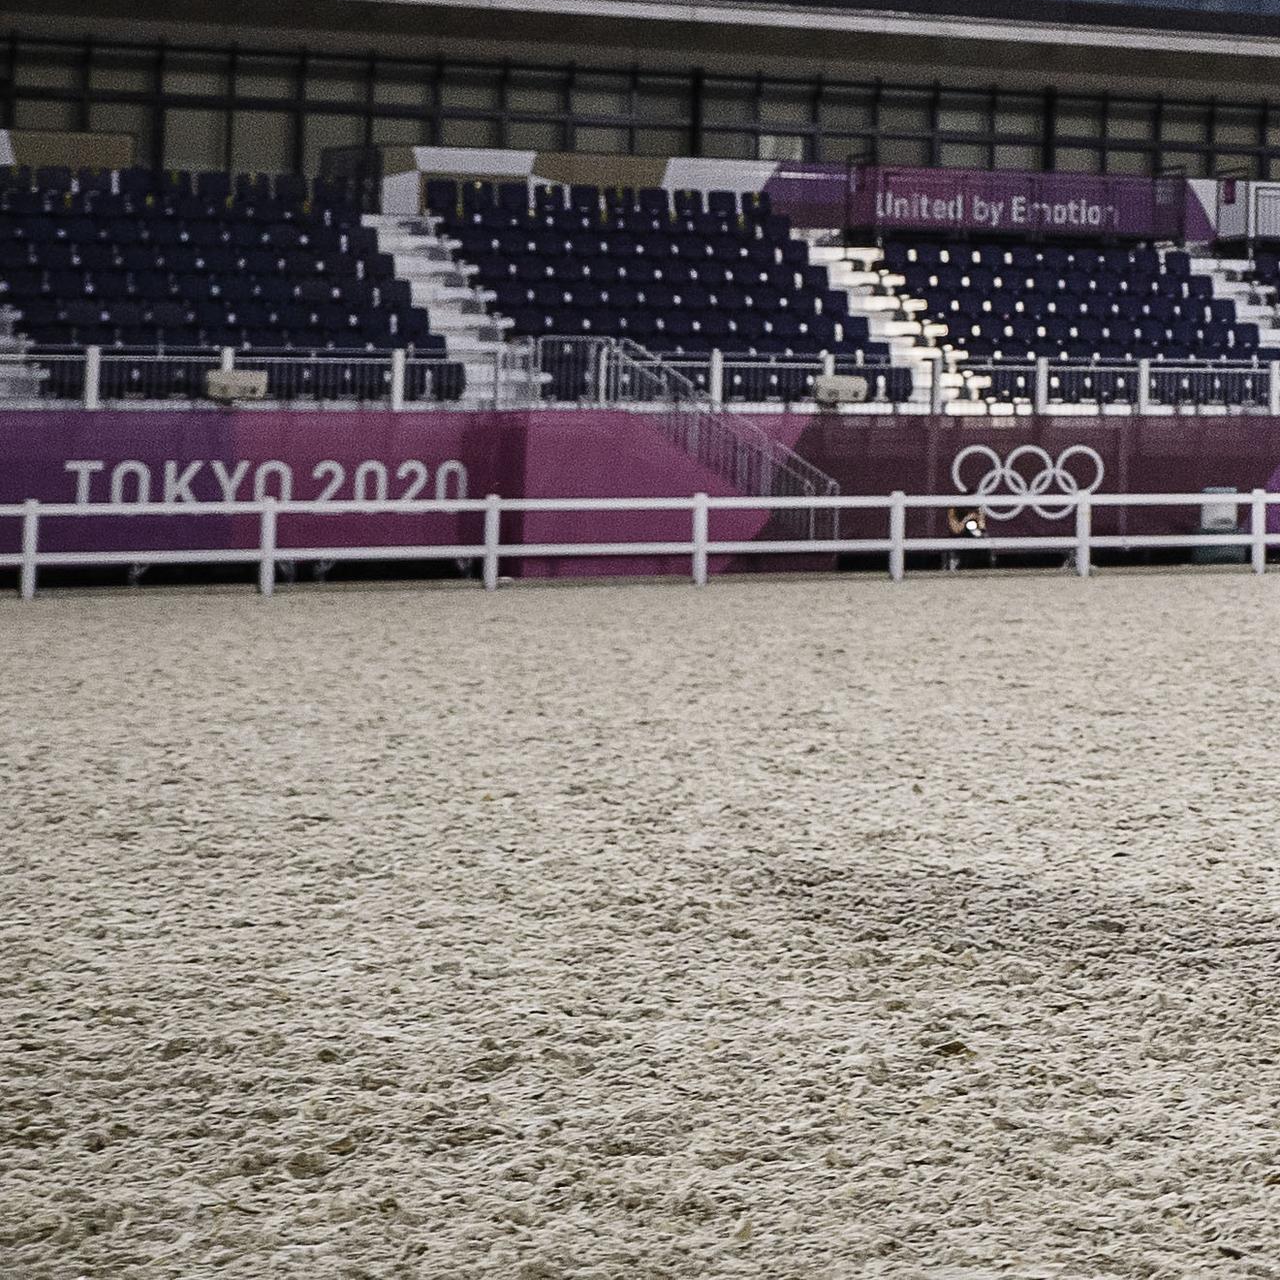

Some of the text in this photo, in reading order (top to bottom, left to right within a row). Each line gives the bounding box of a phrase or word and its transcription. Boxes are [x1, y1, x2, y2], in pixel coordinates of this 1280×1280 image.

[876, 192, 1119, 226] United by Emotion
[64, 460, 468, 510] TOKYO 2020
